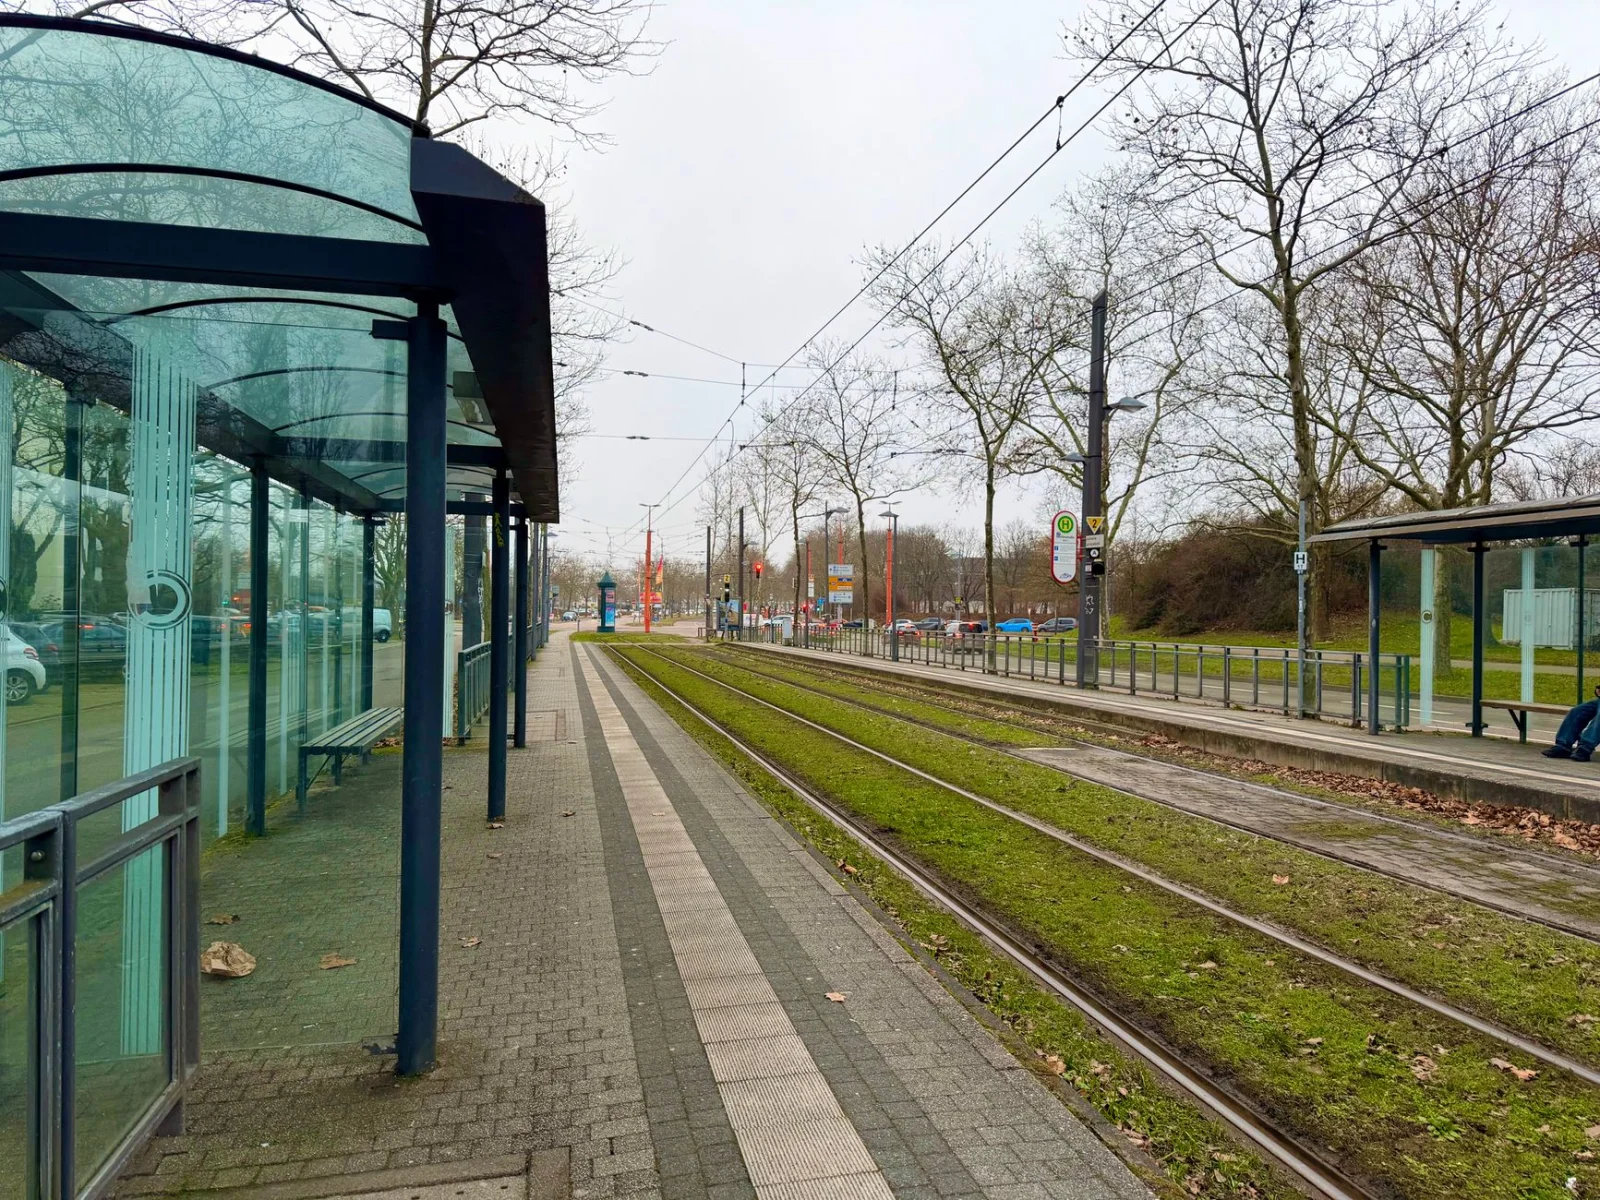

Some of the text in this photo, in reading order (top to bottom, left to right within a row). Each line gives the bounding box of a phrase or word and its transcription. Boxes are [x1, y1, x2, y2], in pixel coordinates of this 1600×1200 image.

[1061, 519, 1070, 529] H
[1092, 518, 1097, 529] 2
[1296, 553, 1306, 564] H
